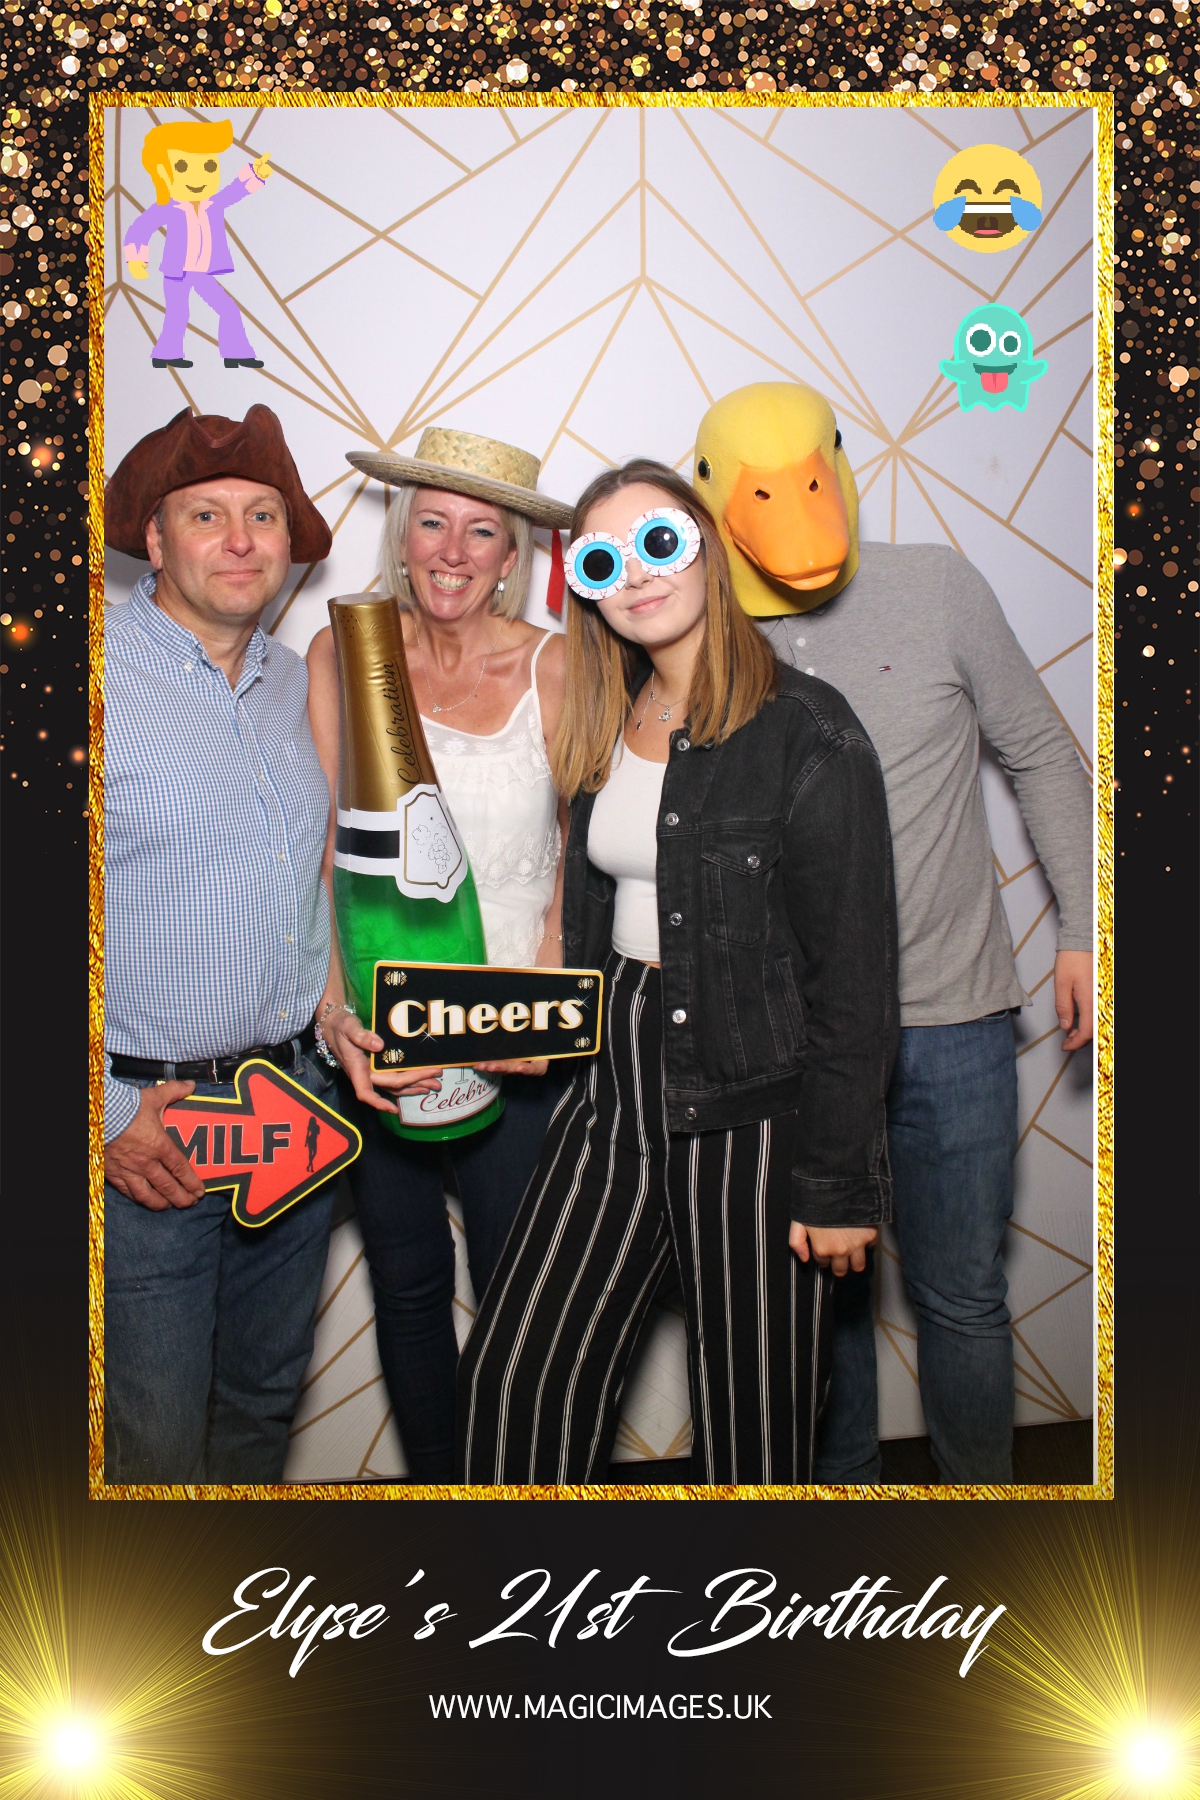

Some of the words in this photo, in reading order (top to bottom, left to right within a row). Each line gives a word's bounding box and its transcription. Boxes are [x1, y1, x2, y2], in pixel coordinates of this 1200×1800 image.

[382, 657, 420, 785] Celebration
[388, 999, 583, 1038] Cheers
[165, 1122, 292, 1166] MILF
